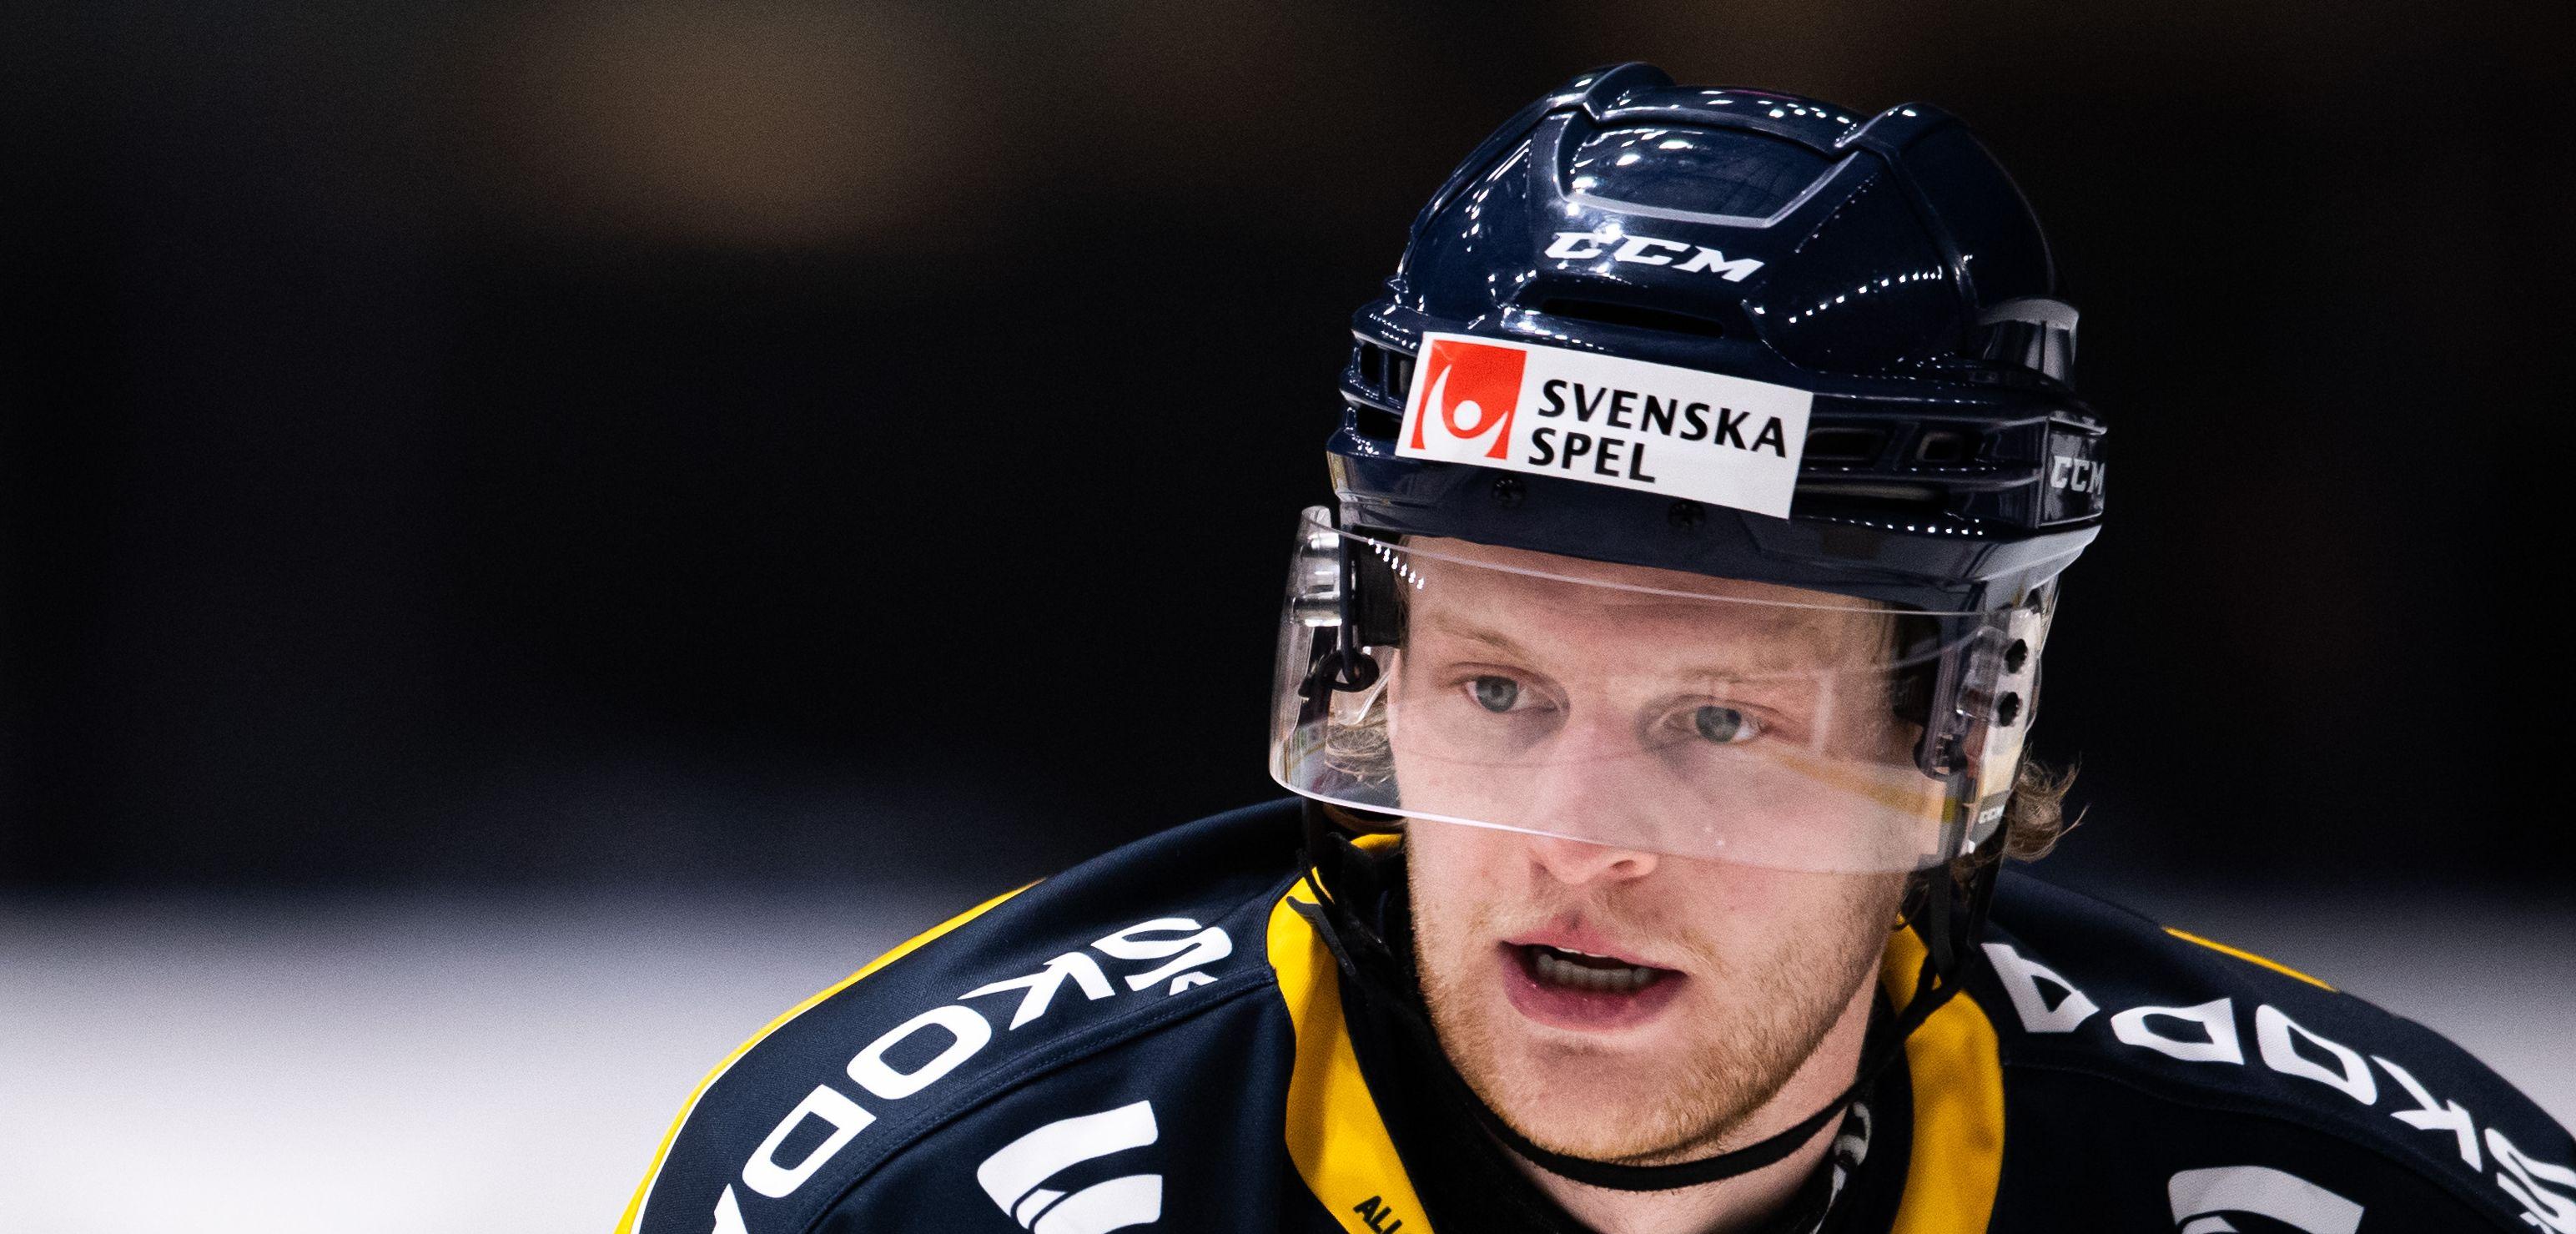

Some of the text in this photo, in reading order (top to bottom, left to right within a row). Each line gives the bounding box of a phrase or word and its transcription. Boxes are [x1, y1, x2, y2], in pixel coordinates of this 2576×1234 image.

[1545, 232, 1764, 282] CCM
[1538, 379, 1786, 458] SVENSKA
[1528, 427, 1655, 483] SPEL
[2050, 456, 2106, 495] CCM
